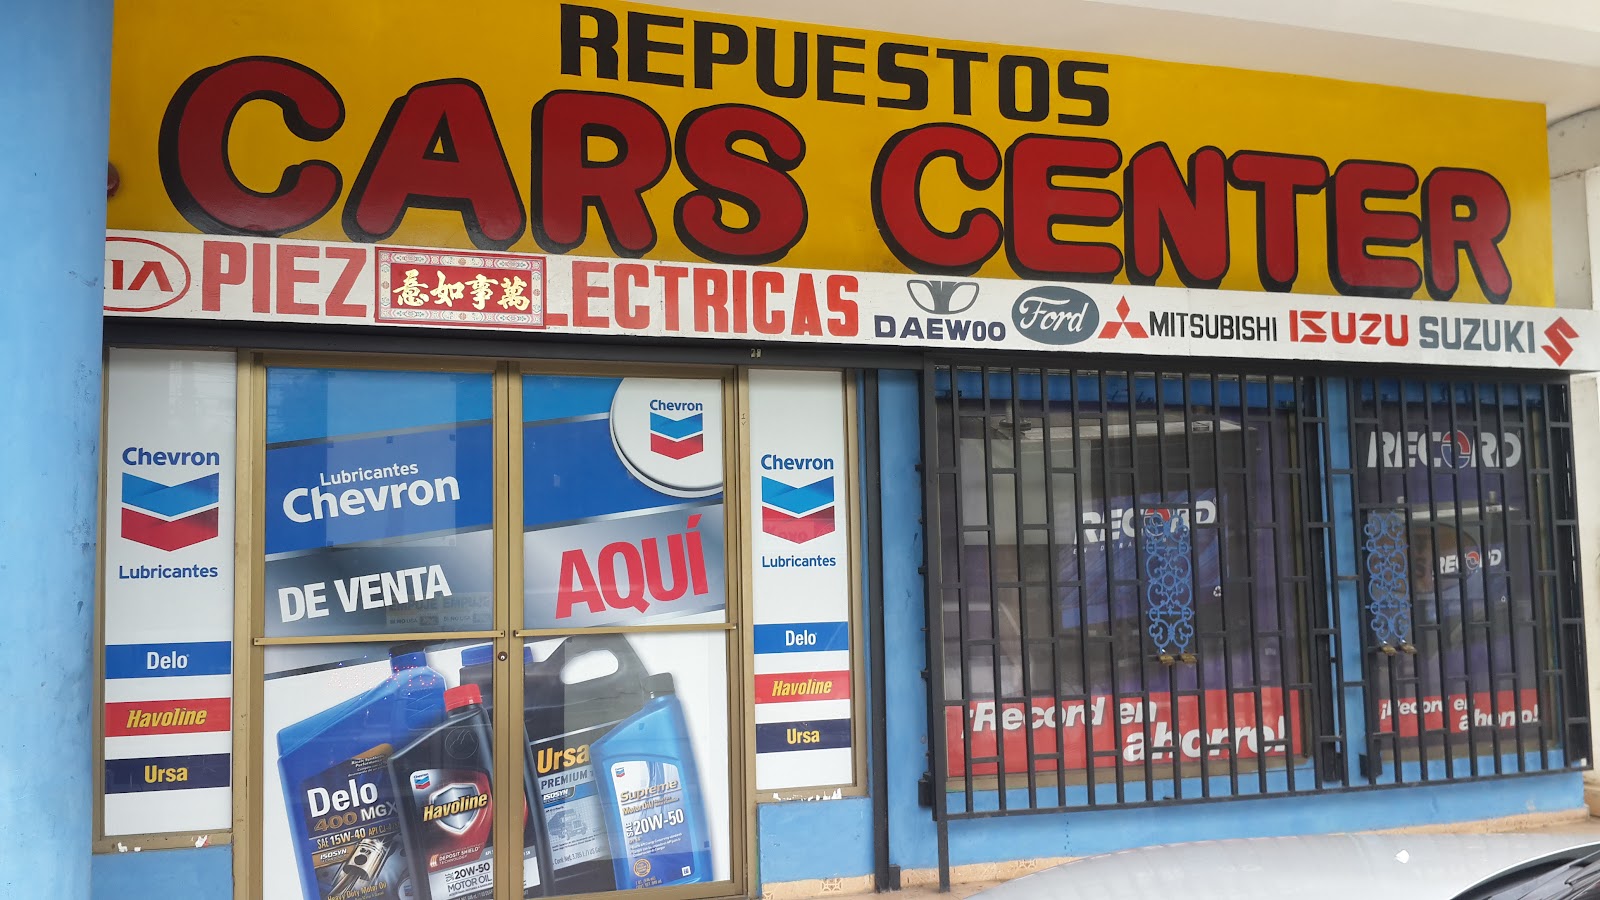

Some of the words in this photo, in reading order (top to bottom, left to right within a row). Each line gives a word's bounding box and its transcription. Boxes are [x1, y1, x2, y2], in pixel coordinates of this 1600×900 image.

[560, 3, 1110, 127] REPUESTOS
[159, 55, 808, 262] CARS
[871, 121, 1512, 304] CENTER
[111, 259, 174, 293] IA
[1018, 295, 1090, 334] Ford
[1148, 310, 1278, 342] MITSUBISHI
[874, 314, 1007, 342] DAEWOO
[1289, 309, 1409, 347] ISUZU
[1418, 316, 1536, 354] SUZUKI
[649, 399, 703, 412] Chevron
[121, 446, 220, 467] Chevron
[1366, 429, 1522, 469] RECORD
[760, 454, 835, 471] Chevron
[319, 462, 419, 487] Lubricantes
[282, 475, 461, 523] Chevron
[118, 564, 219, 580] Lubricantes
[555, 513, 709, 620] AQUÍ
[761, 555, 837, 568] Lubricantes
[278, 581, 330, 623] DE
[333, 564, 453, 614] VENTA
[785, 629, 817, 647] Delo
[146, 651, 188, 671] Delo
[771, 678, 833, 697] Havoline
[126, 707, 207, 729] Havoline
[1119, 701, 1158, 725] en
[786, 727, 820, 745] Ursa
[1123, 715, 1286, 762] ahorro!
[537, 744, 590, 774] Ursa
[144, 764, 188, 783] Ursa
[541, 769, 588, 791] PREMIUM
[307, 778, 379, 818] Delo
[543, 788, 569, 801] ISOSYN
[620, 779, 679, 803] Supreme
[423, 793, 488, 822] Havoline
[314, 811, 358, 832] 400
[625, 821, 634, 838] SAE
[633, 808, 684, 836] 20W-50
[317, 837, 330, 850] SAE
[330, 827, 367, 847] 15W-40
[320, 847, 348, 860] ISOSYN
[439, 851, 461, 862] DEPOSIT
[454, 862, 491, 880] 20W-50
[447, 877, 478, 893] MOTOR
[478, 874, 493, 884] OIL
